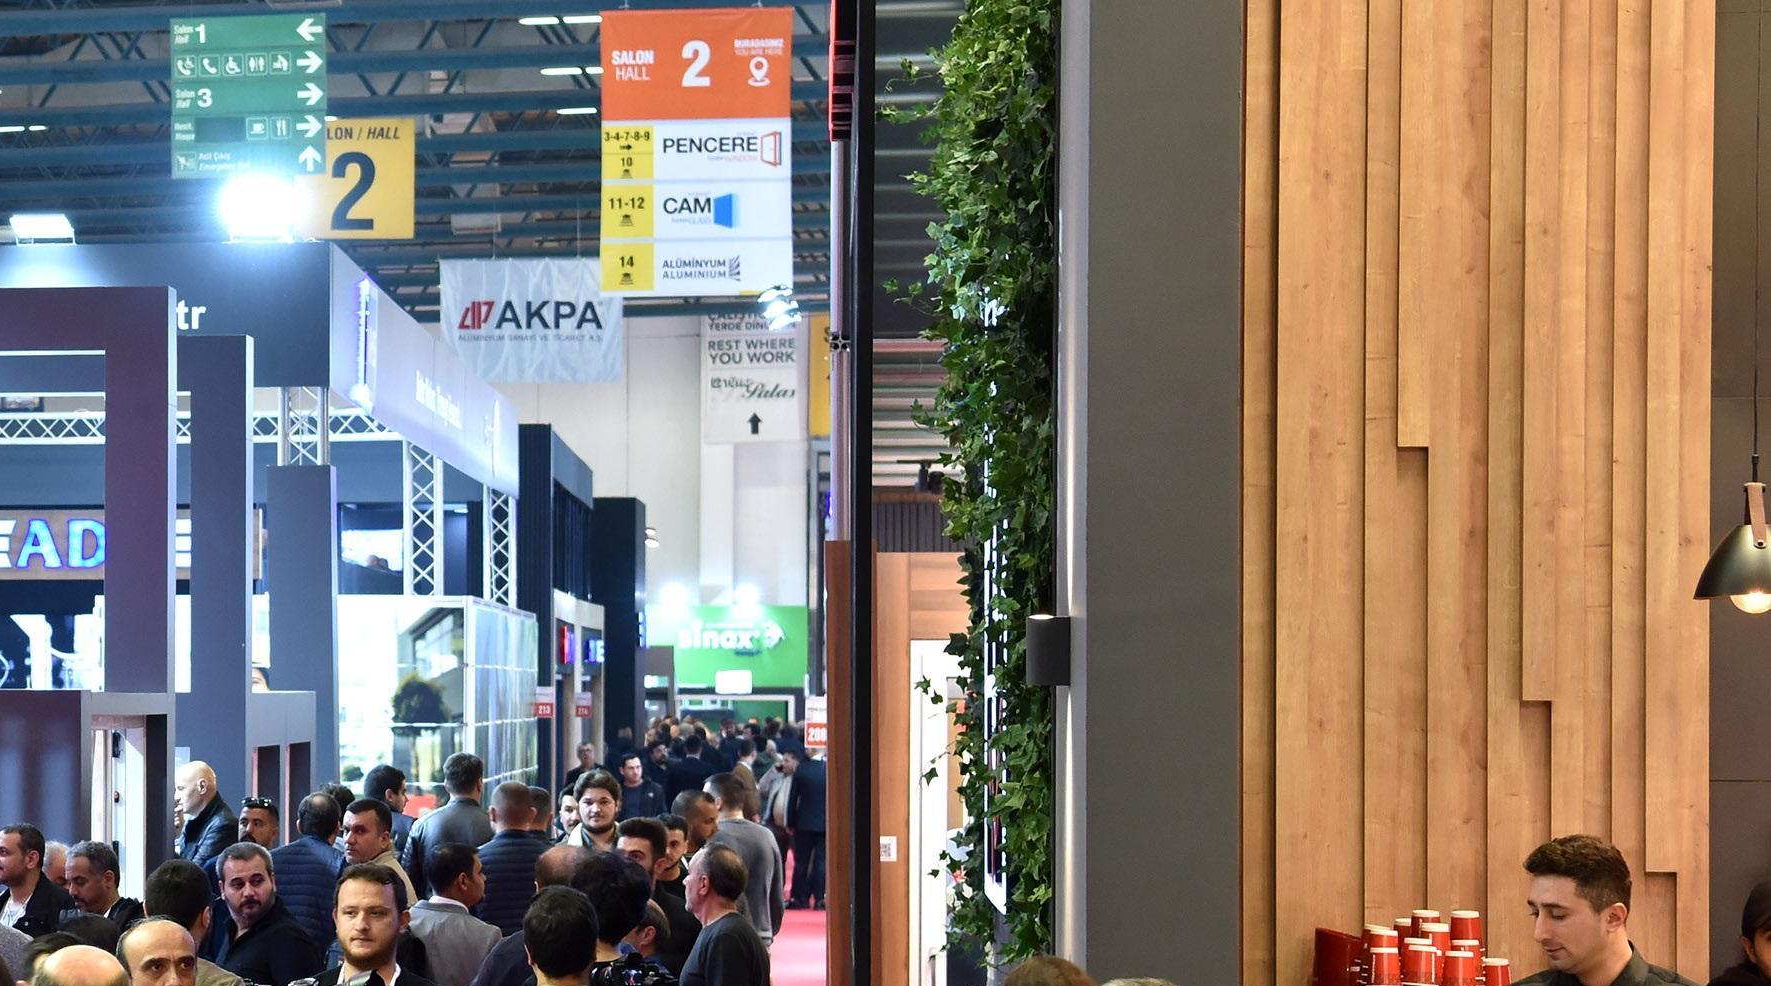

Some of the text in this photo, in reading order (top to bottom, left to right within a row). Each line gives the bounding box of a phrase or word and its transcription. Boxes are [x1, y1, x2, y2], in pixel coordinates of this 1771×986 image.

[194, 23, 206, 44] 1
[611, 50, 655, 65] SALON
[681, 40, 711, 88] 2
[615, 66, 651, 81] HALL
[197, 87, 213, 108] 3
[366, 126, 401, 140] HALL
[603, 131, 651, 143] 3-4-7-8-9
[662, 136, 759, 154] PENCERE
[620, 157, 633, 168] 10
[330, 151, 376, 231] 2
[608, 197, 645, 210] 11-12
[663, 197, 712, 215] CAM
[619, 256, 635, 268] 14
[662, 270, 726, 280] ALUMINIUM
[495, 300, 603, 330] AKPA
[708, 338, 796, 352] REST WHERE
[709, 351, 795, 365] YOU WORK
